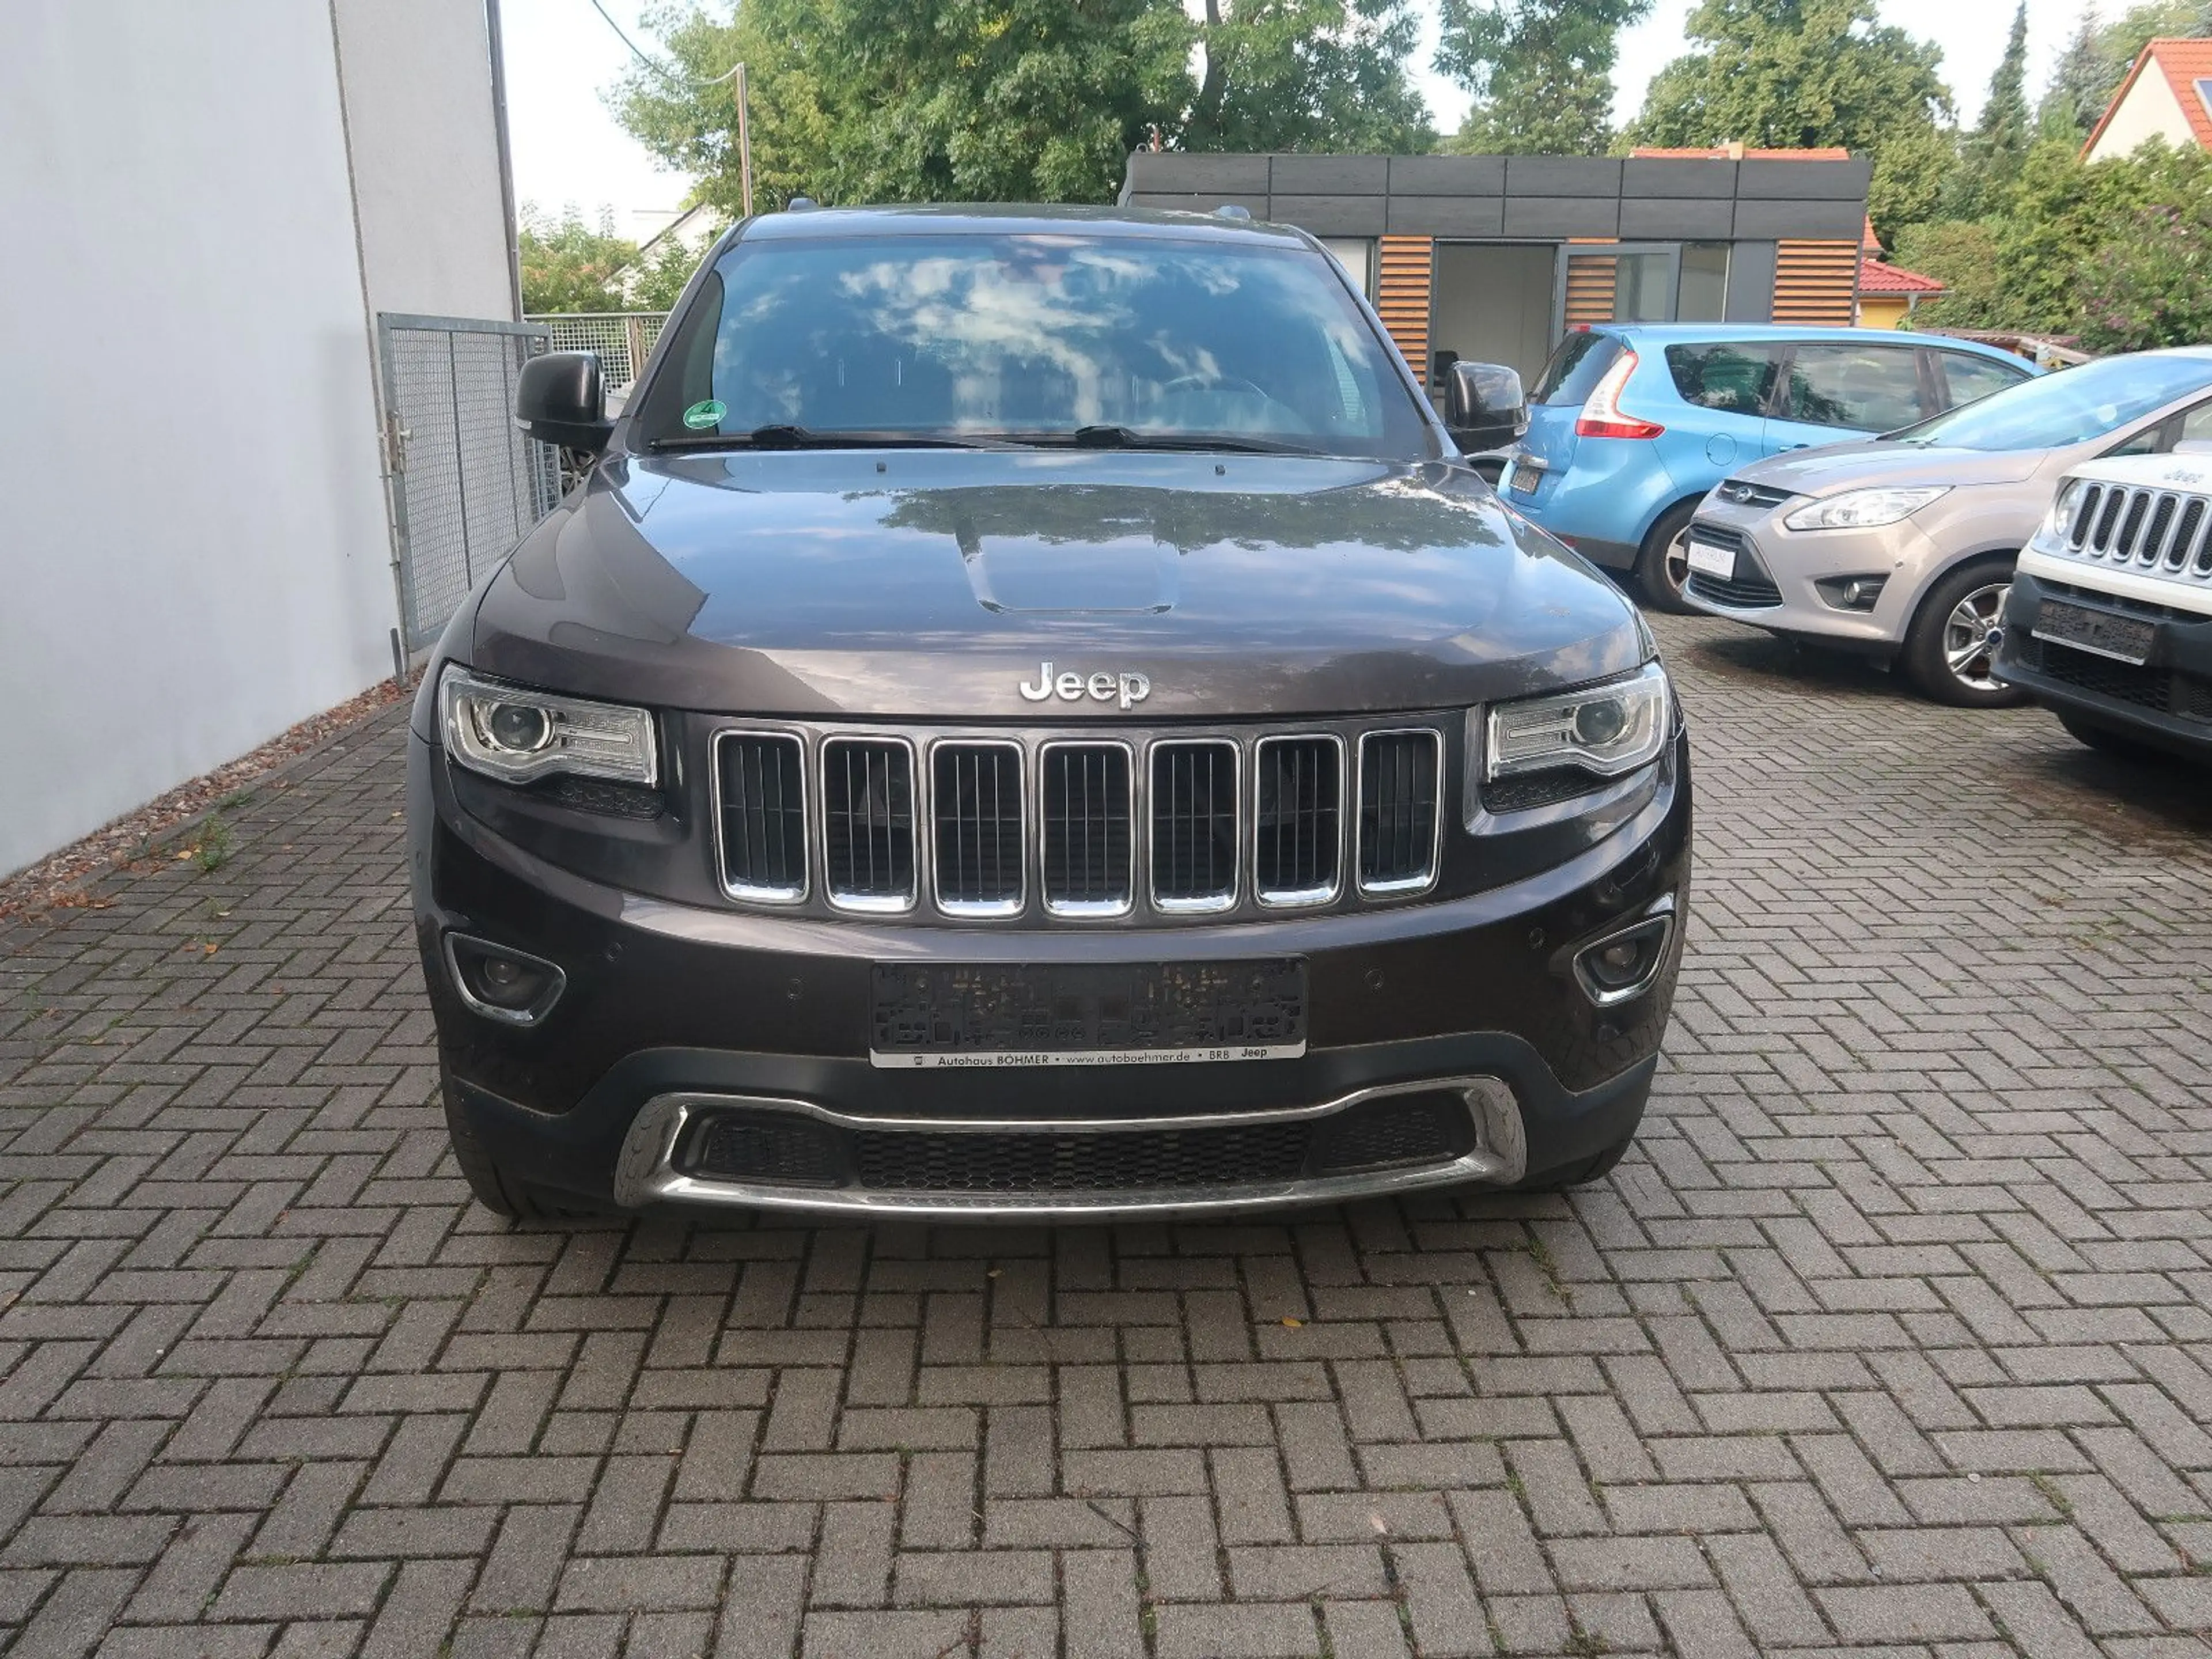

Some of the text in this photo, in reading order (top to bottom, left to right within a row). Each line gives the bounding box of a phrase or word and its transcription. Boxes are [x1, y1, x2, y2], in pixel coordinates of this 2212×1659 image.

[1020, 662, 1151, 710] Jeep
[938, 1056, 993, 1065] Autohaus
[1209, 1050, 1230, 1060] BRB
[1241, 1048, 1267, 1058] Jeep
